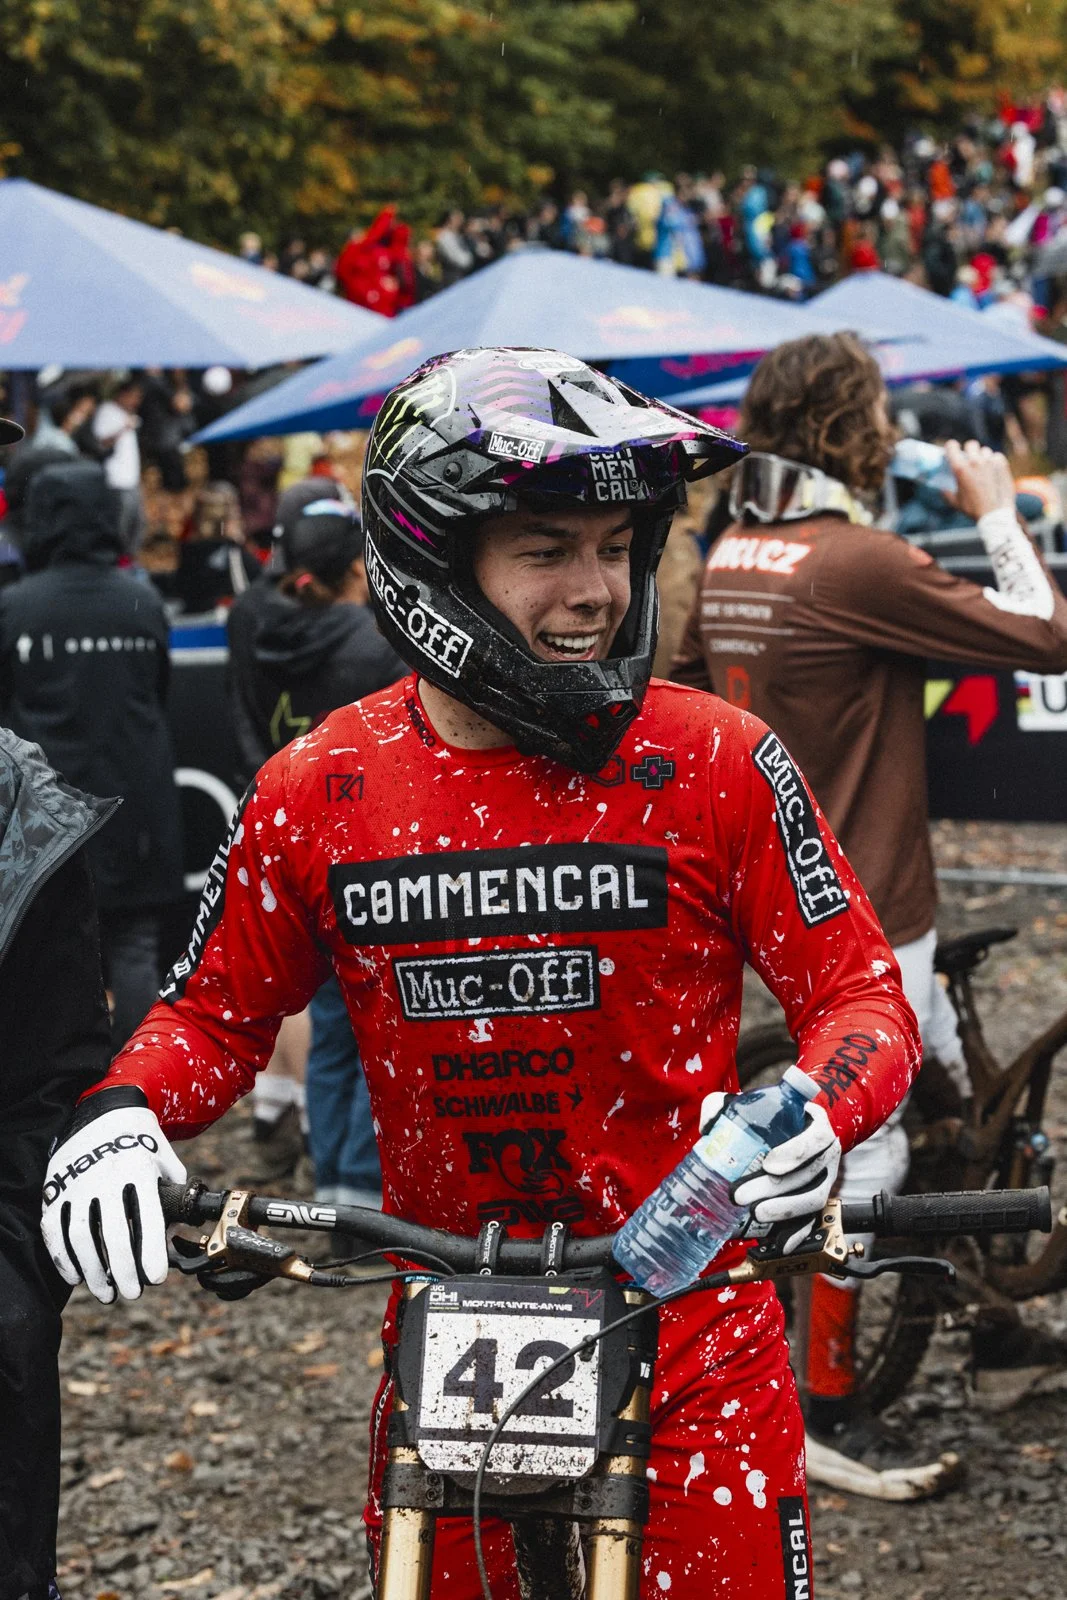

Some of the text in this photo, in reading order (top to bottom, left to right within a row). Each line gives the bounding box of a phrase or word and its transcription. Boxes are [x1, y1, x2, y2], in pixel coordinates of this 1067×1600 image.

[491, 434, 542, 460] Muc-Off
[591, 459, 637, 481] MEN
[595, 480, 636, 501] CAL
[367, 542, 463, 668] Muc-Off
[764, 743, 843, 911] Muc-Off
[343, 864, 649, 926] COMMENCAL
[405, 958, 584, 1010] Muc-Off
[433, 1091, 561, 1118] SCHWALBE
[462, 1127, 572, 1186] FOX
[443, 1337, 576, 1418] 42
